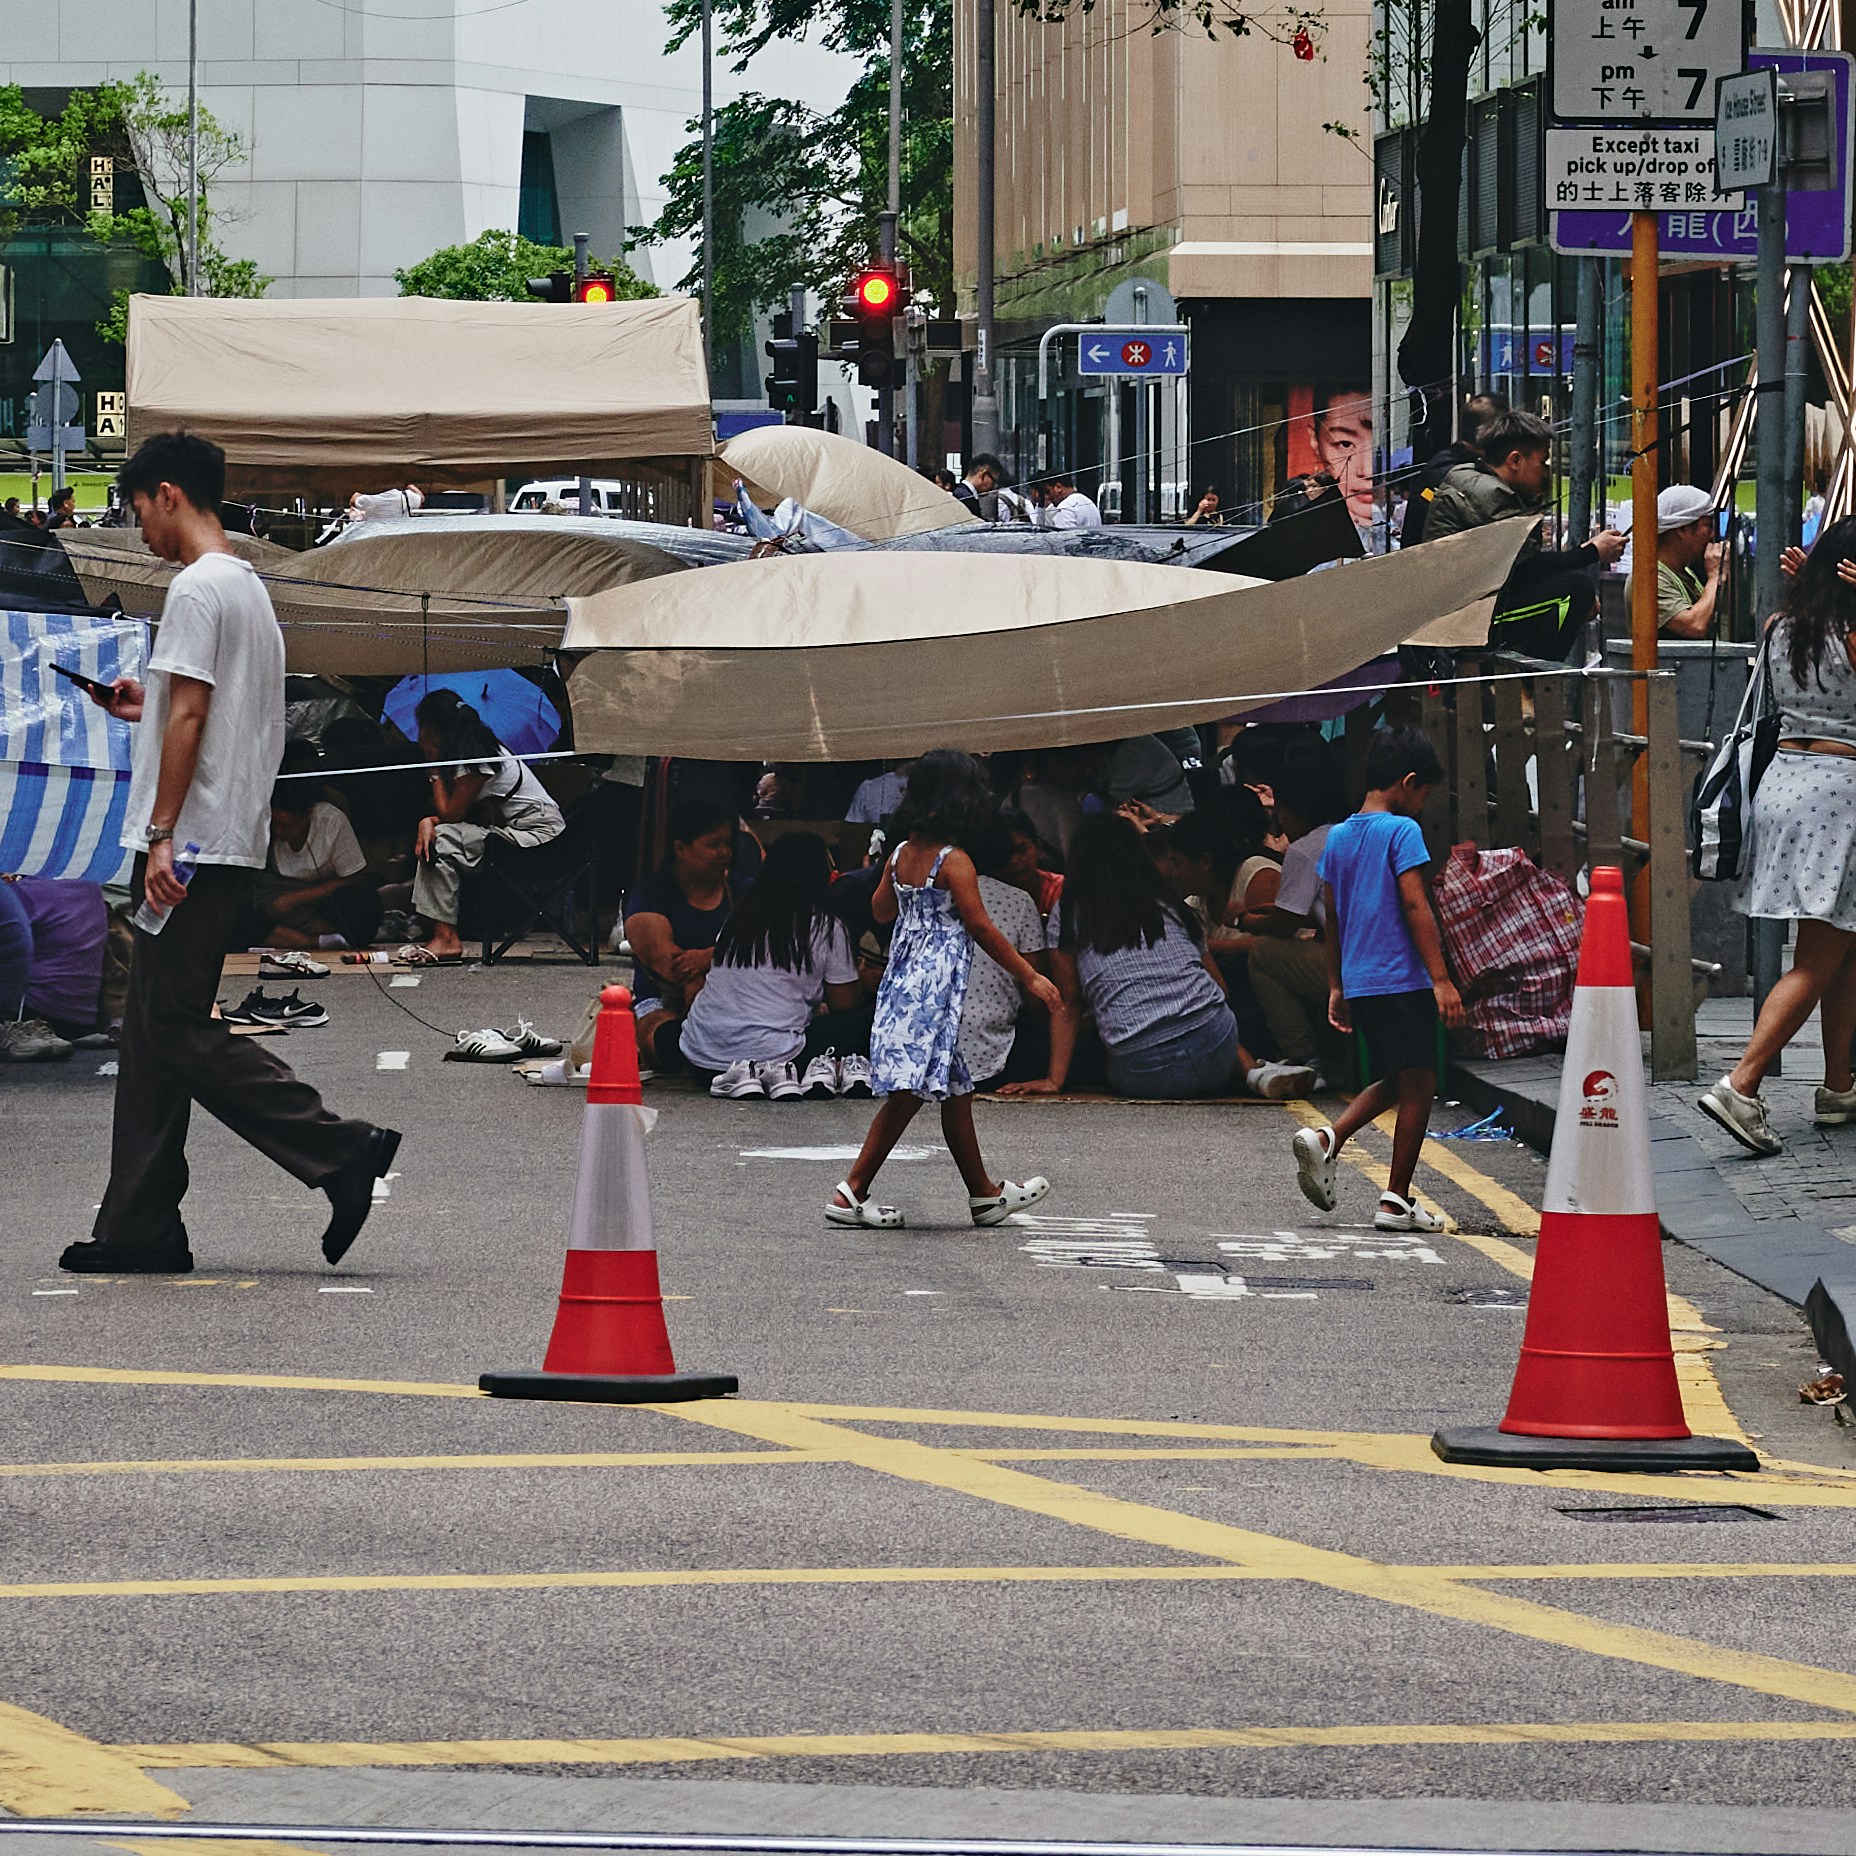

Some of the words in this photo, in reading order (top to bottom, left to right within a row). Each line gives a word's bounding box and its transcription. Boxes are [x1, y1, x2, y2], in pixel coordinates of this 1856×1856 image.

[1591, 16, 1647, 40] 上午
[1601, 63, 1635, 83] pm
[1591, 87, 1646, 110] 下午
[1677, 68, 1708, 110] 7
[1592, 136, 1658, 157] Except
[1663, 136, 1700, 153] taxi
[1567, 157, 1607, 177] pick
[1612, 156, 1689, 177] up/drop
[1695, 157, 1716, 174] of
